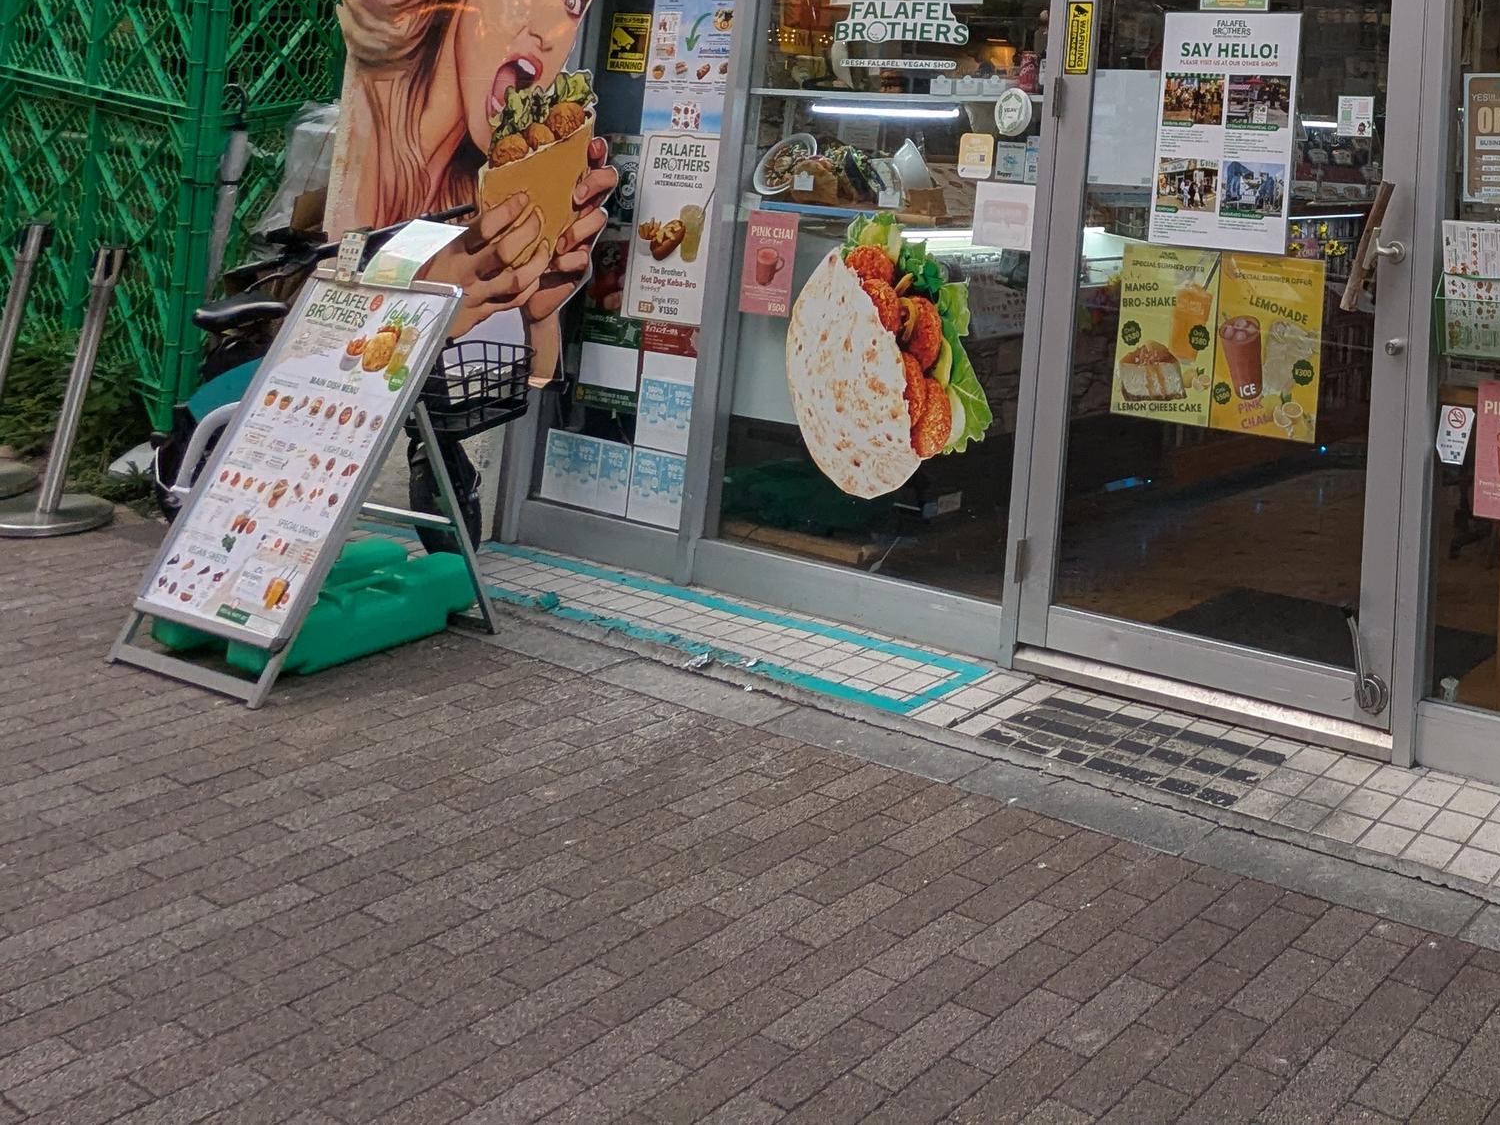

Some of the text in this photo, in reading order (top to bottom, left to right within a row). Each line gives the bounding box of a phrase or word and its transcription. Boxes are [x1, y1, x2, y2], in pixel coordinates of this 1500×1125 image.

[851, 2, 955, 21] FALAFEL
[835, 21, 968, 45] BROTHERS
[1181, 42, 1279, 59] SAY HELLO!
[609, 60, 642, 70] WARNING
[867, 59, 900, 67] FALAFEL
[660, 143, 707, 158] FALAFEL
[653, 158, 710, 173] BROTHERS
[751, 225, 794, 241] PINK CHAI
[641, 275, 652, 285] Hot
[653, 276, 666, 287] Dog
[1125, 282, 1159, 292] MANGO
[321, 289, 370, 311] FALAFEL
[1122, 296, 1177, 307] BRO-SHAKE
[305, 303, 368, 328] BROTHERS
[1249, 294, 1309, 325] LEMONADE
[1239, 383, 1257, 397] ICE
[1117, 402, 1202, 412] LEMON CHEESE CAKE
